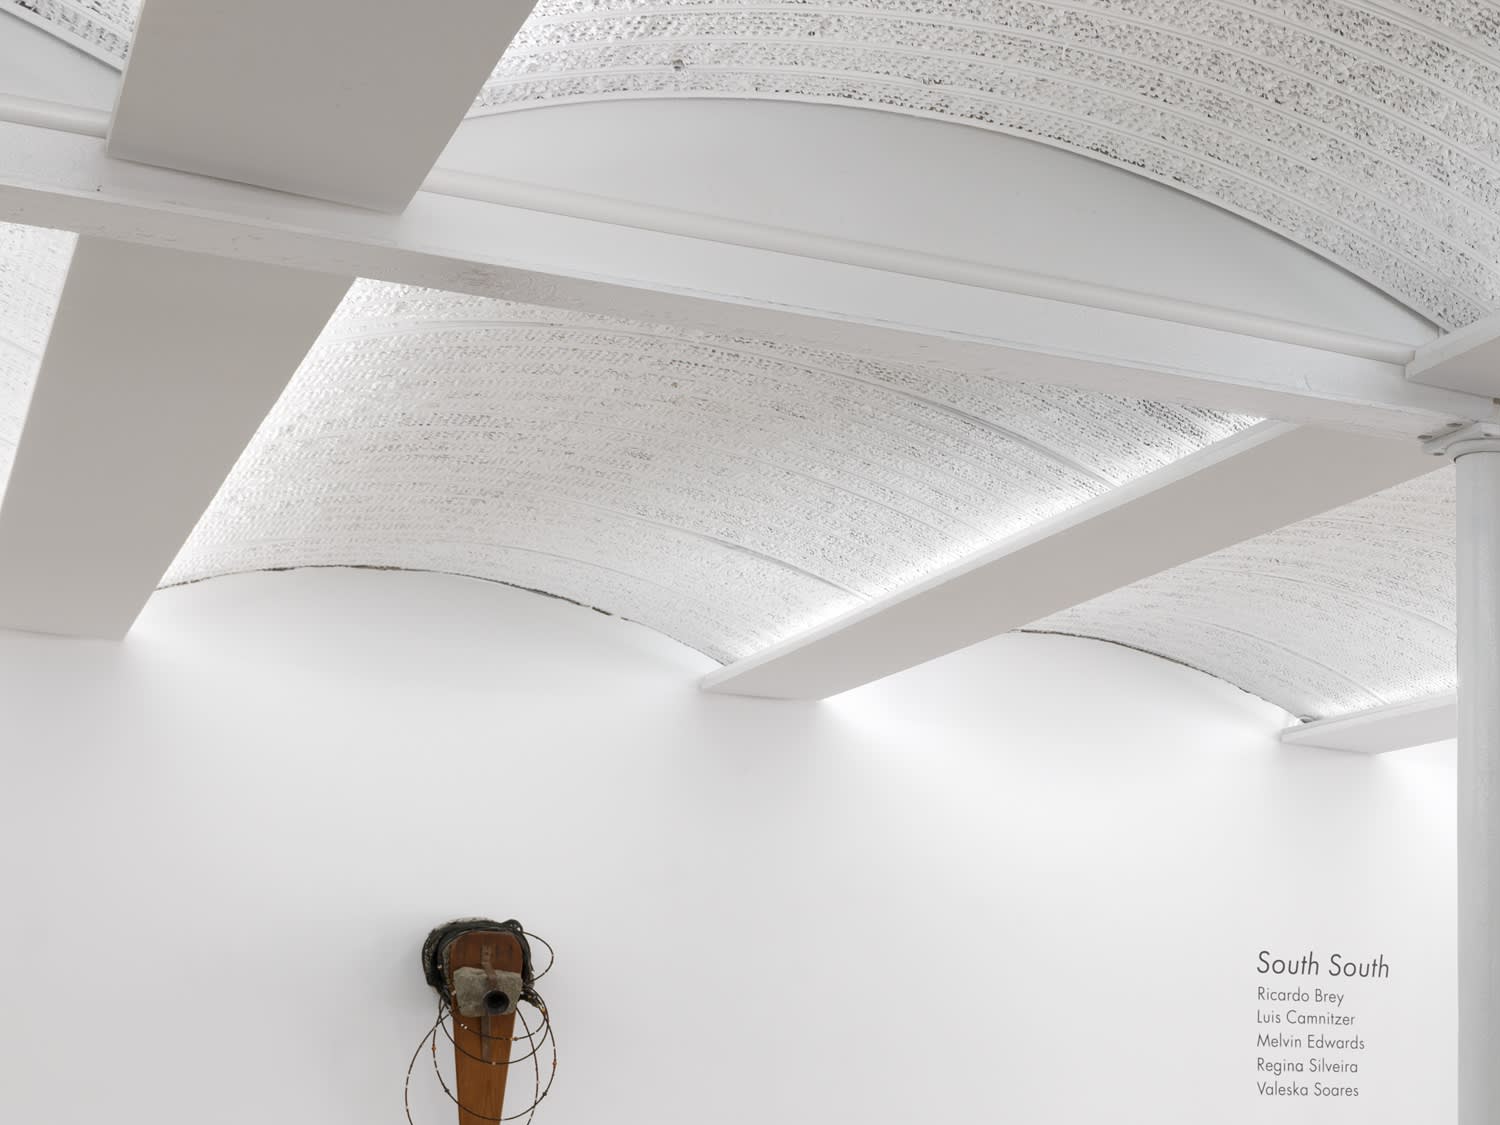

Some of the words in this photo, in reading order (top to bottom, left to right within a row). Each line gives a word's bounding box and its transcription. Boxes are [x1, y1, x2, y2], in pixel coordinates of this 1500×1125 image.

[1257, 951, 1319, 975] South
[1329, 954, 1389, 978] South
[1257, 986, 1310, 1002] Ricardo
[1315, 988, 1344, 1007] Brey
[1257, 1009, 1281, 1024] Luis
[1286, 1010, 1356, 1026] Camnitzer
[1257, 1033, 1302, 1048] Melvin
[1307, 1034, 1365, 1050] Edwards
[1257, 1057, 1304, 1076] Regina
[1309, 1057, 1358, 1073] Silveira
[1257, 1081, 1309, 1096] Valeska
[1314, 1082, 1359, 1097] Soares
